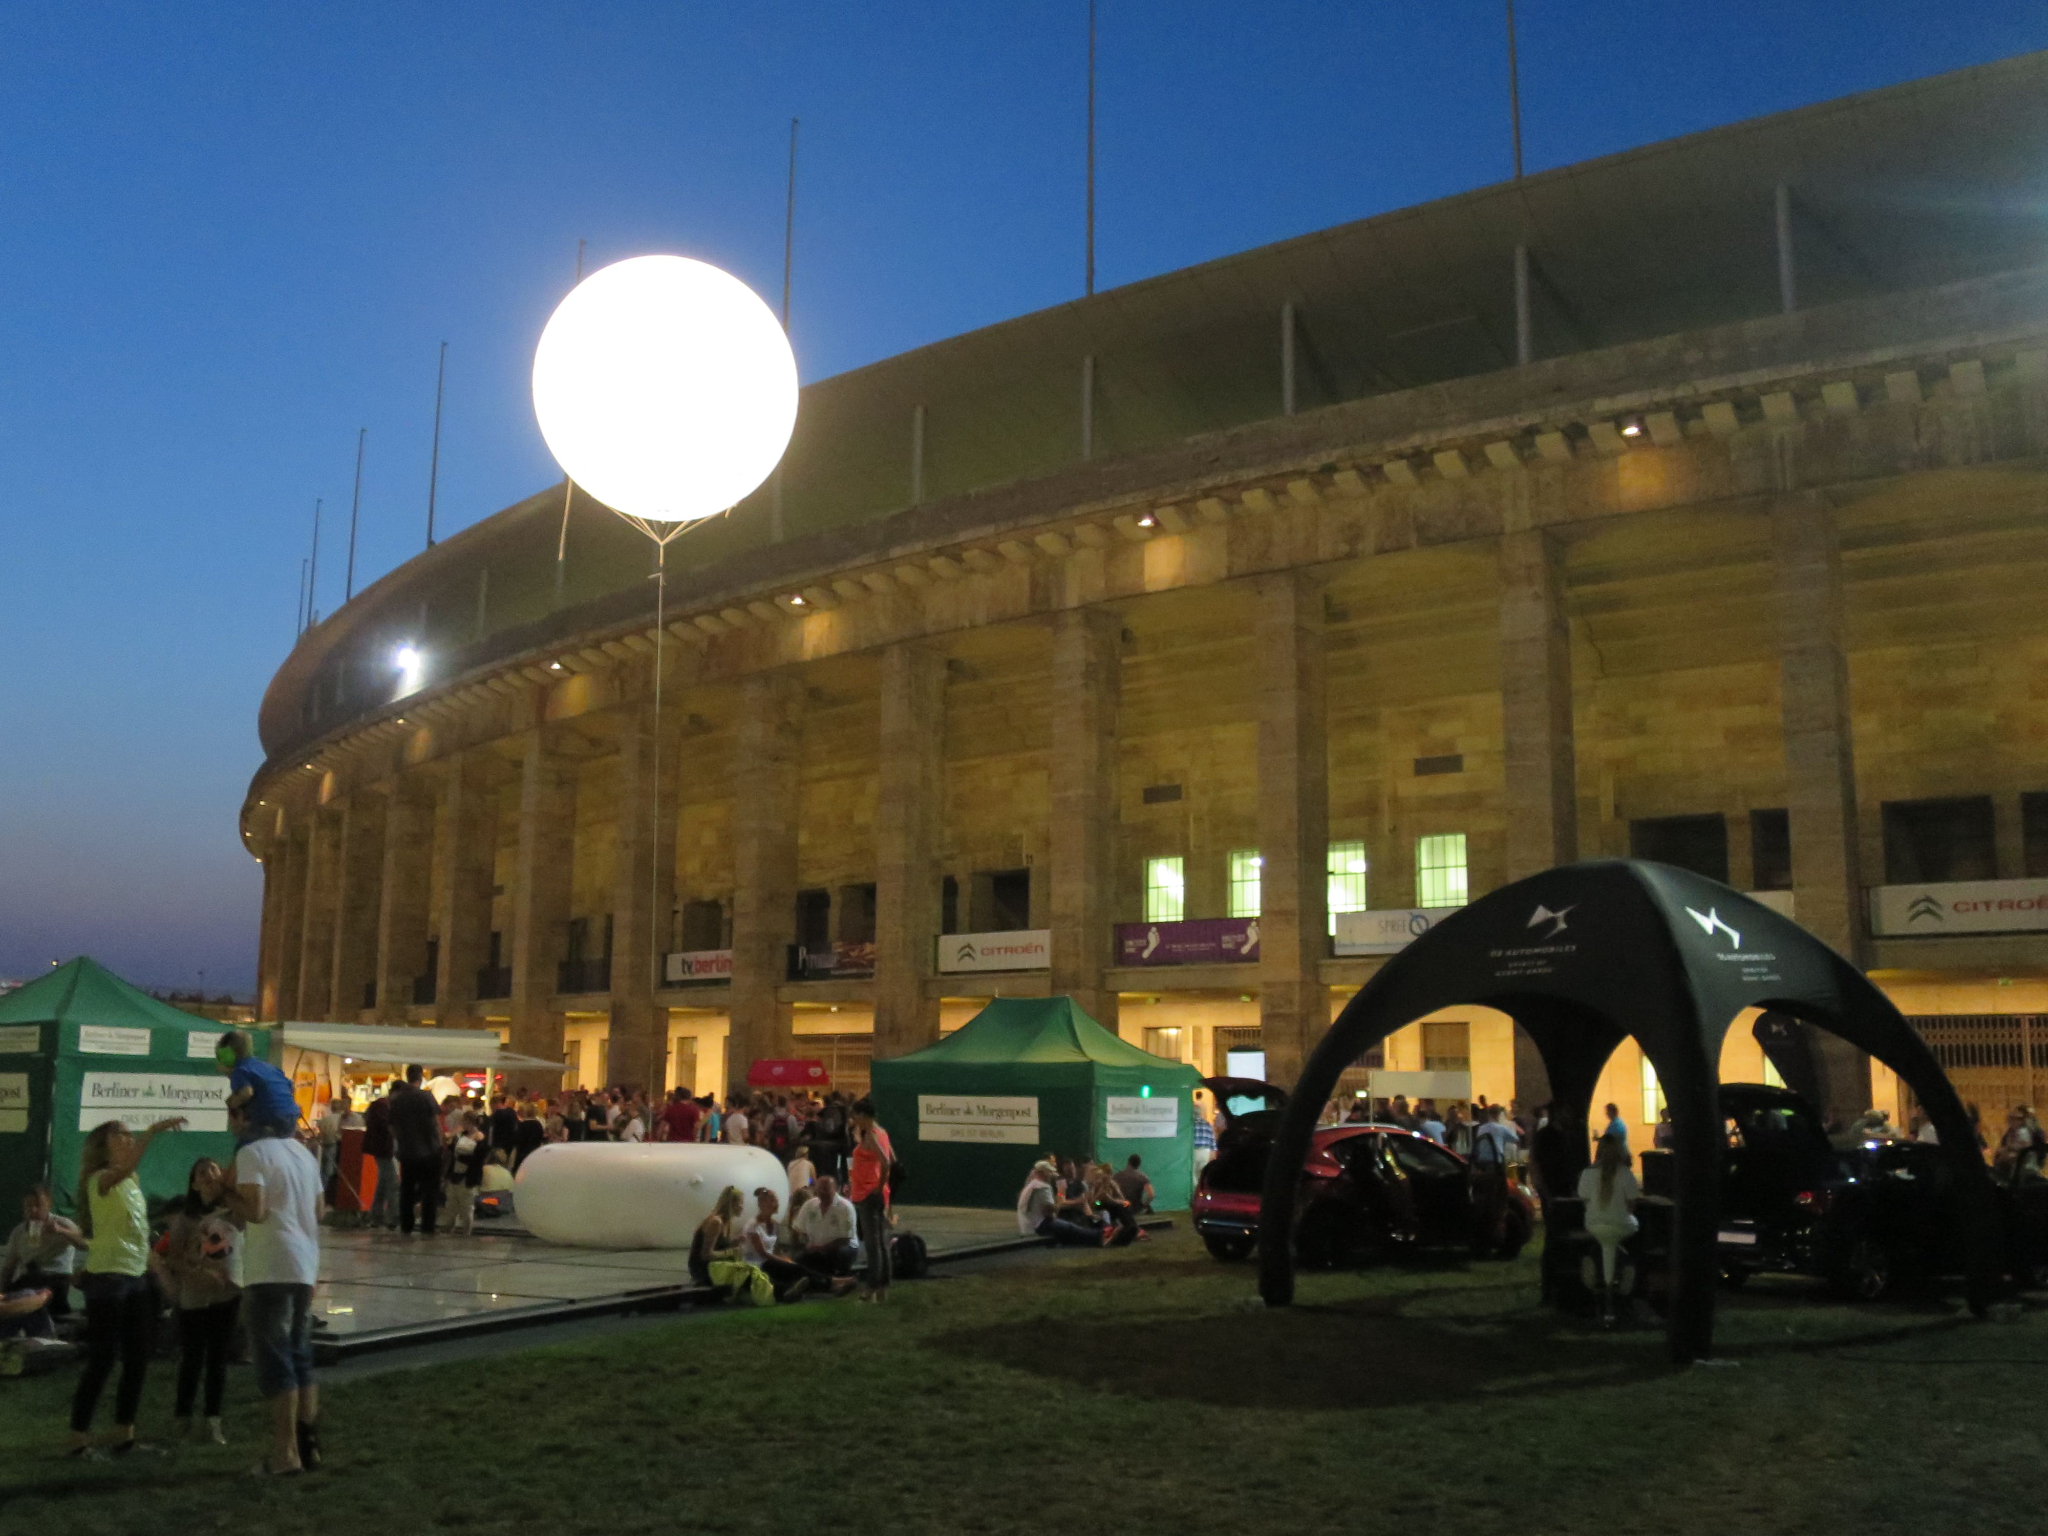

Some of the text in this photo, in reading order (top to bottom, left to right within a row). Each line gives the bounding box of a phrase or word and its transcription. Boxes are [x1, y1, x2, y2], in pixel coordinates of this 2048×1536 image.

[91, 1081, 224, 1104] Berliner Morgenpost
[925, 1103, 1032, 1120] Berliner Morgenpost
